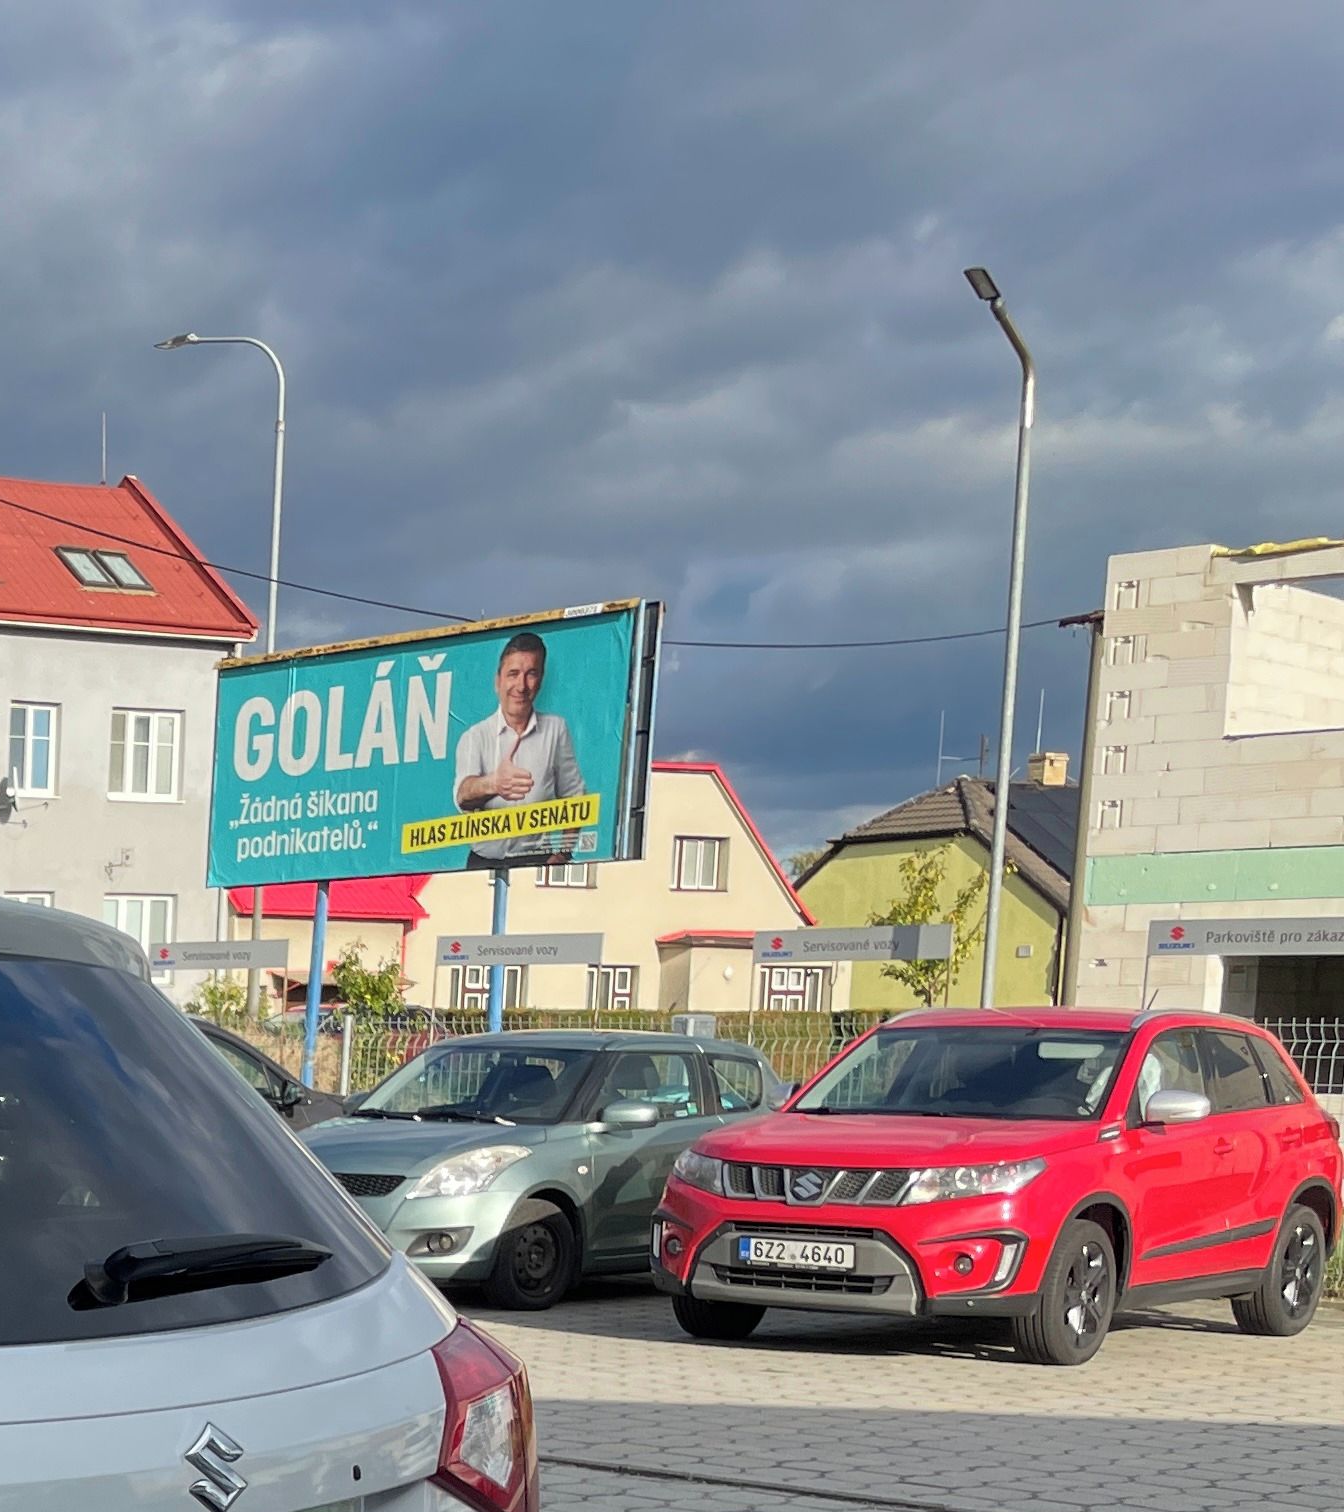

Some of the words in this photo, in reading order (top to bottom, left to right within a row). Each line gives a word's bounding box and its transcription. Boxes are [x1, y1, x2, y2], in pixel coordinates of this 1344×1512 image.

[233, 653, 453, 782] GOLÁŇ
[307, 789, 378, 818] šikana
[410, 823, 446, 847] HLAS
[450, 811, 511, 840] ZLÍNSKA
[516, 811, 527, 830] V
[529, 800, 591, 828] SENÁTU
[803, 939, 870, 952] Servisované
[874, 940, 900, 951] vozy
[1206, 930, 1275, 944] Parkoviště
[1280, 931, 1302, 945] pro
[477, 944, 533, 957] Servisované
[537, 945, 559, 956] vozy
[754, 1241, 786, 1260] 6Z2
[800, 1245, 845, 1265] 4640
